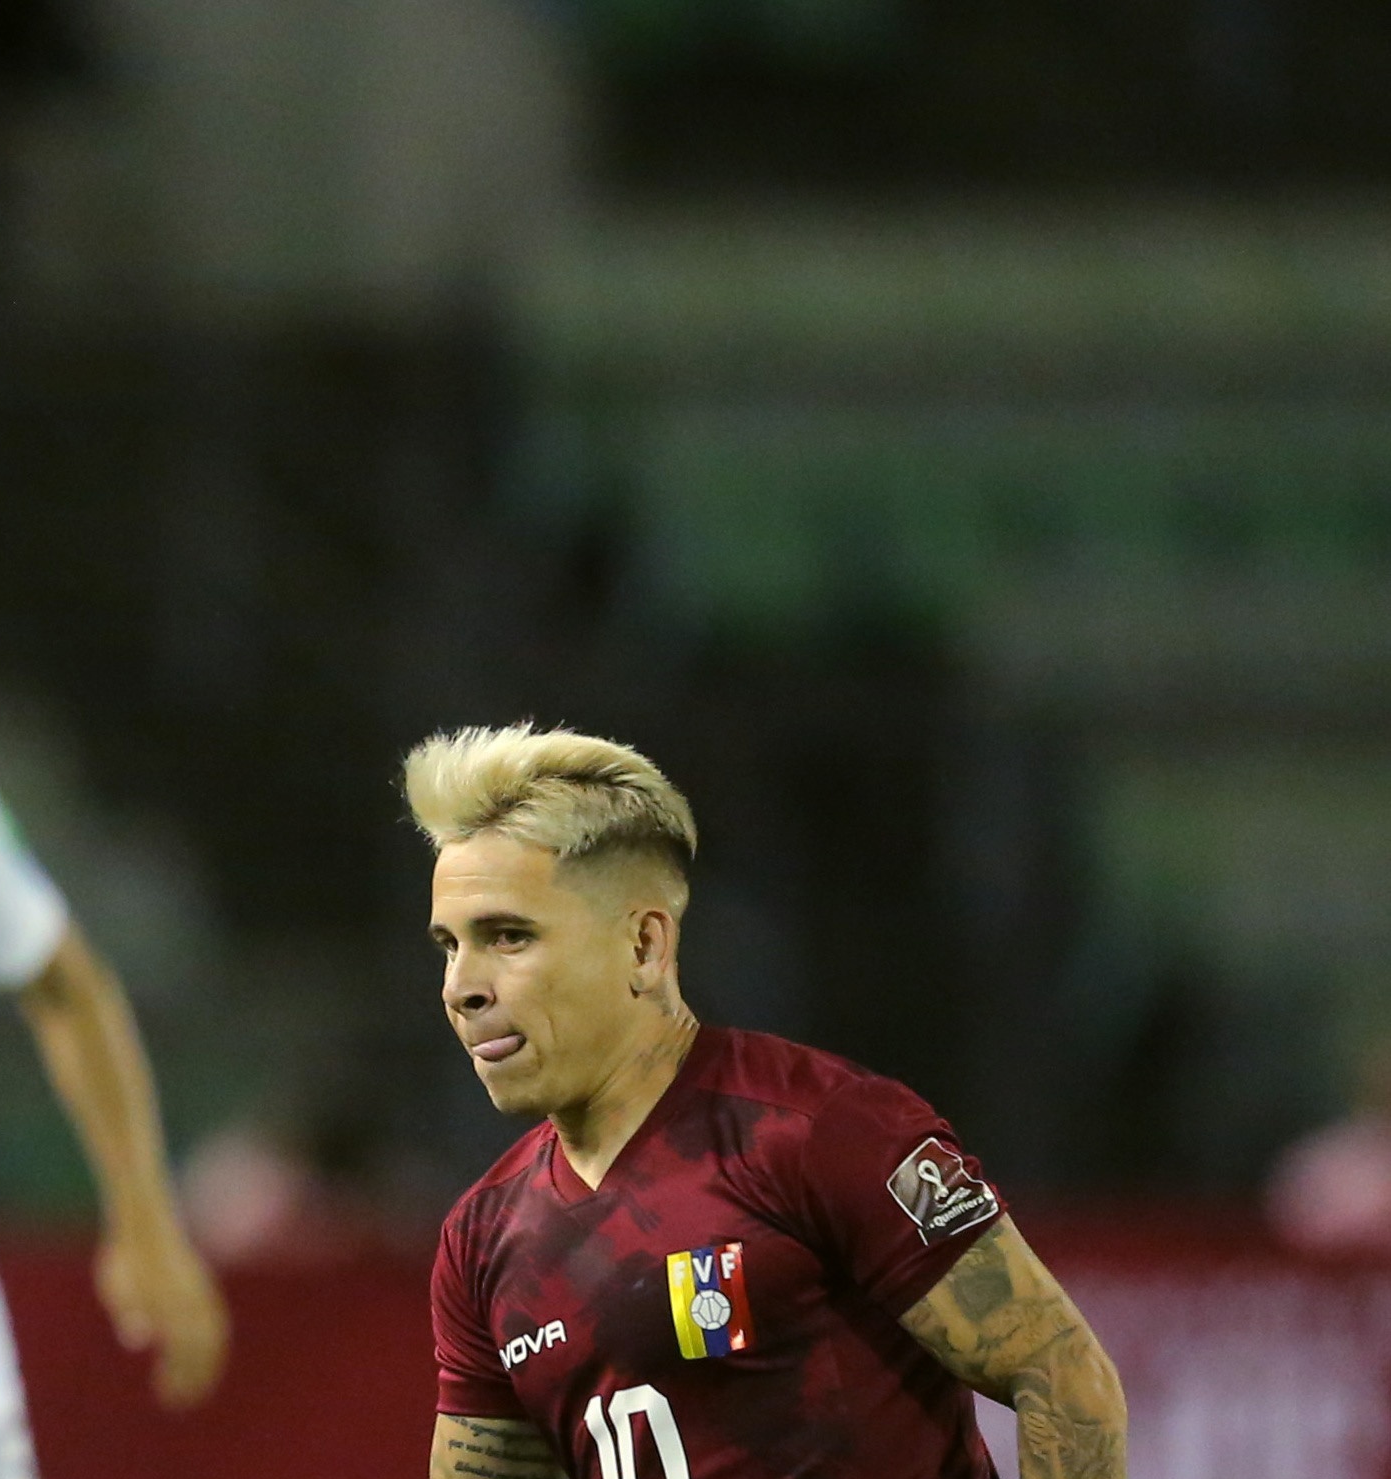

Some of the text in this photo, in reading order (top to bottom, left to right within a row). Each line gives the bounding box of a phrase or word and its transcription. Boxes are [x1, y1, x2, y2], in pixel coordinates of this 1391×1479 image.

[933, 1195, 984, 1227] Qualifiers
[672, 1251, 736, 1287] FVF
[499, 1319, 567, 1371] VOVA
